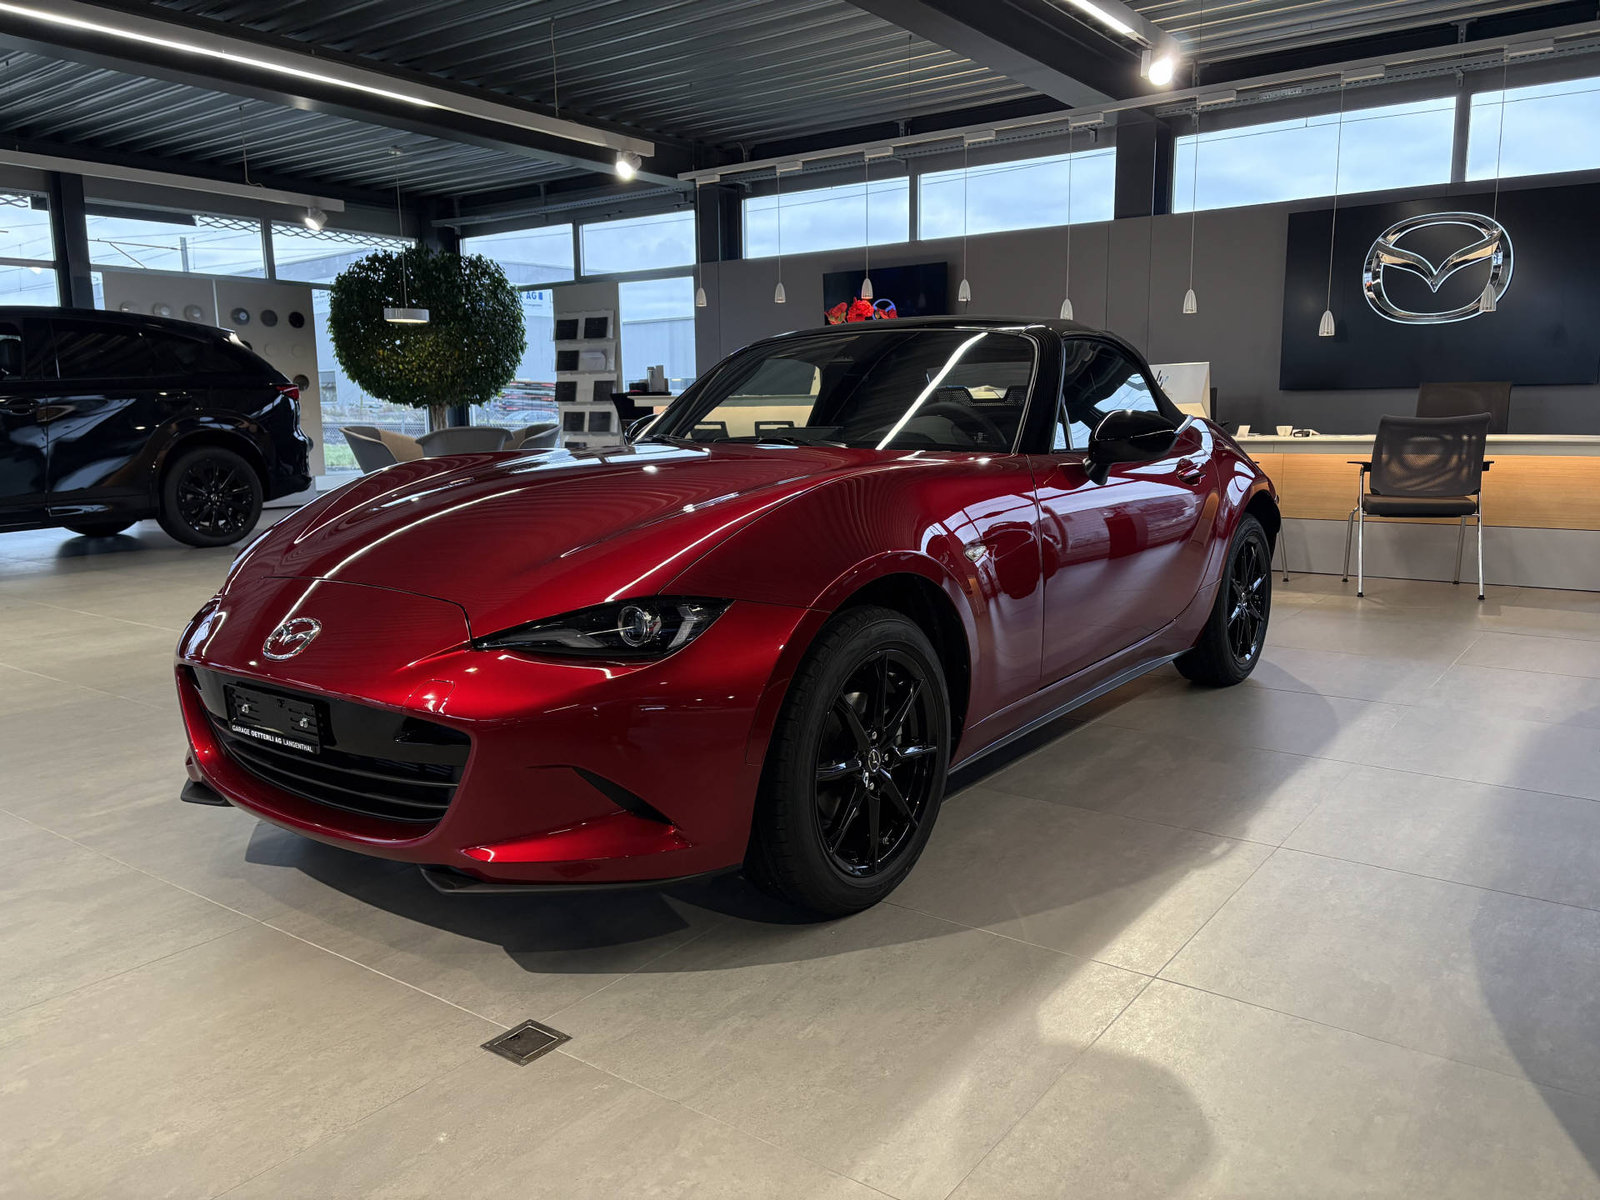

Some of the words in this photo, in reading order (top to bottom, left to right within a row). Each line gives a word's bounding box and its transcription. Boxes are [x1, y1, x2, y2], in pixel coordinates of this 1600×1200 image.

[526, 291, 537, 300] AG
[232, 724, 250, 735] GARAGE
[251, 730, 274, 742] OETTERLI
[283, 739, 314, 753] LANGENTHAL
